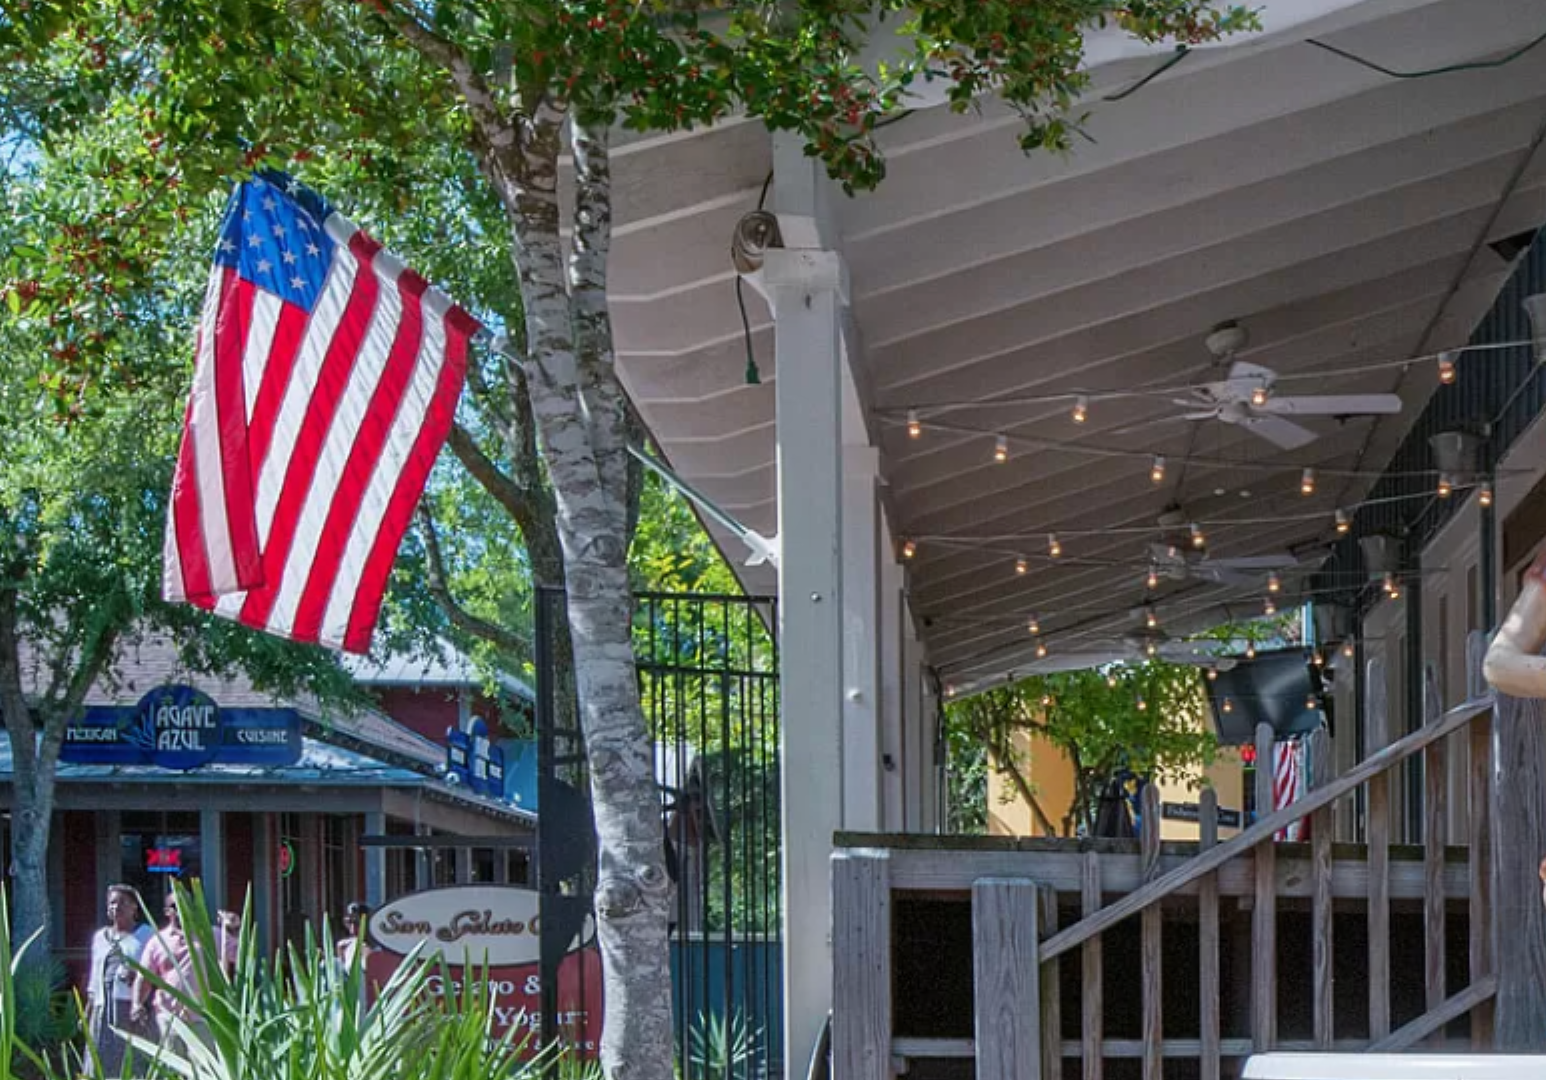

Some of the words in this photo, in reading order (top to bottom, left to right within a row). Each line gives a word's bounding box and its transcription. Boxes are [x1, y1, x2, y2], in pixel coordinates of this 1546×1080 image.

[156, 705, 216, 729] AGAVE
[66, 727, 117, 742] MEXICAN
[157, 730, 206, 751] AZUL
[236, 729, 288, 744] CUISINE
[426, 974, 514, 997] Geato
[523, 974, 542, 995] &
